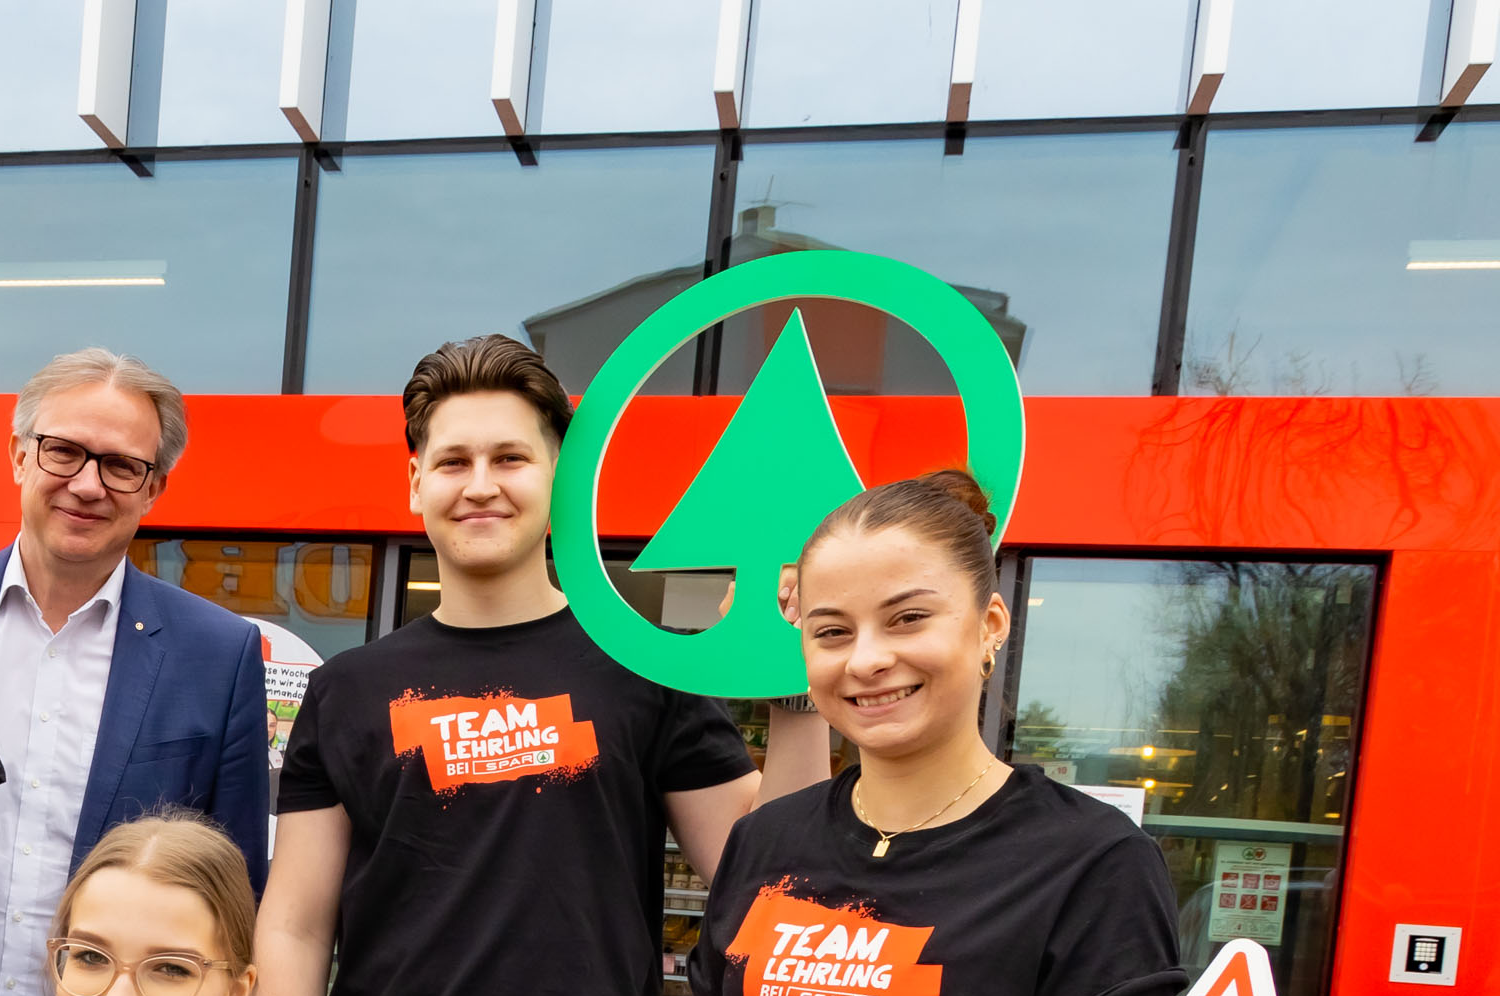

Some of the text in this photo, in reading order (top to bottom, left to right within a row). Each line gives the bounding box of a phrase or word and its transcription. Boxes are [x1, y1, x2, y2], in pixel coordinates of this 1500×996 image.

[279, 679, 294, 687] wir
[430, 703, 538, 741] TEAM
[444, 726, 559, 760] LEHRLING
[446, 755, 533, 776] BEI SPAR
[773, 922, 890, 962] TEAM
[763, 958, 893, 990] LEHRLING
